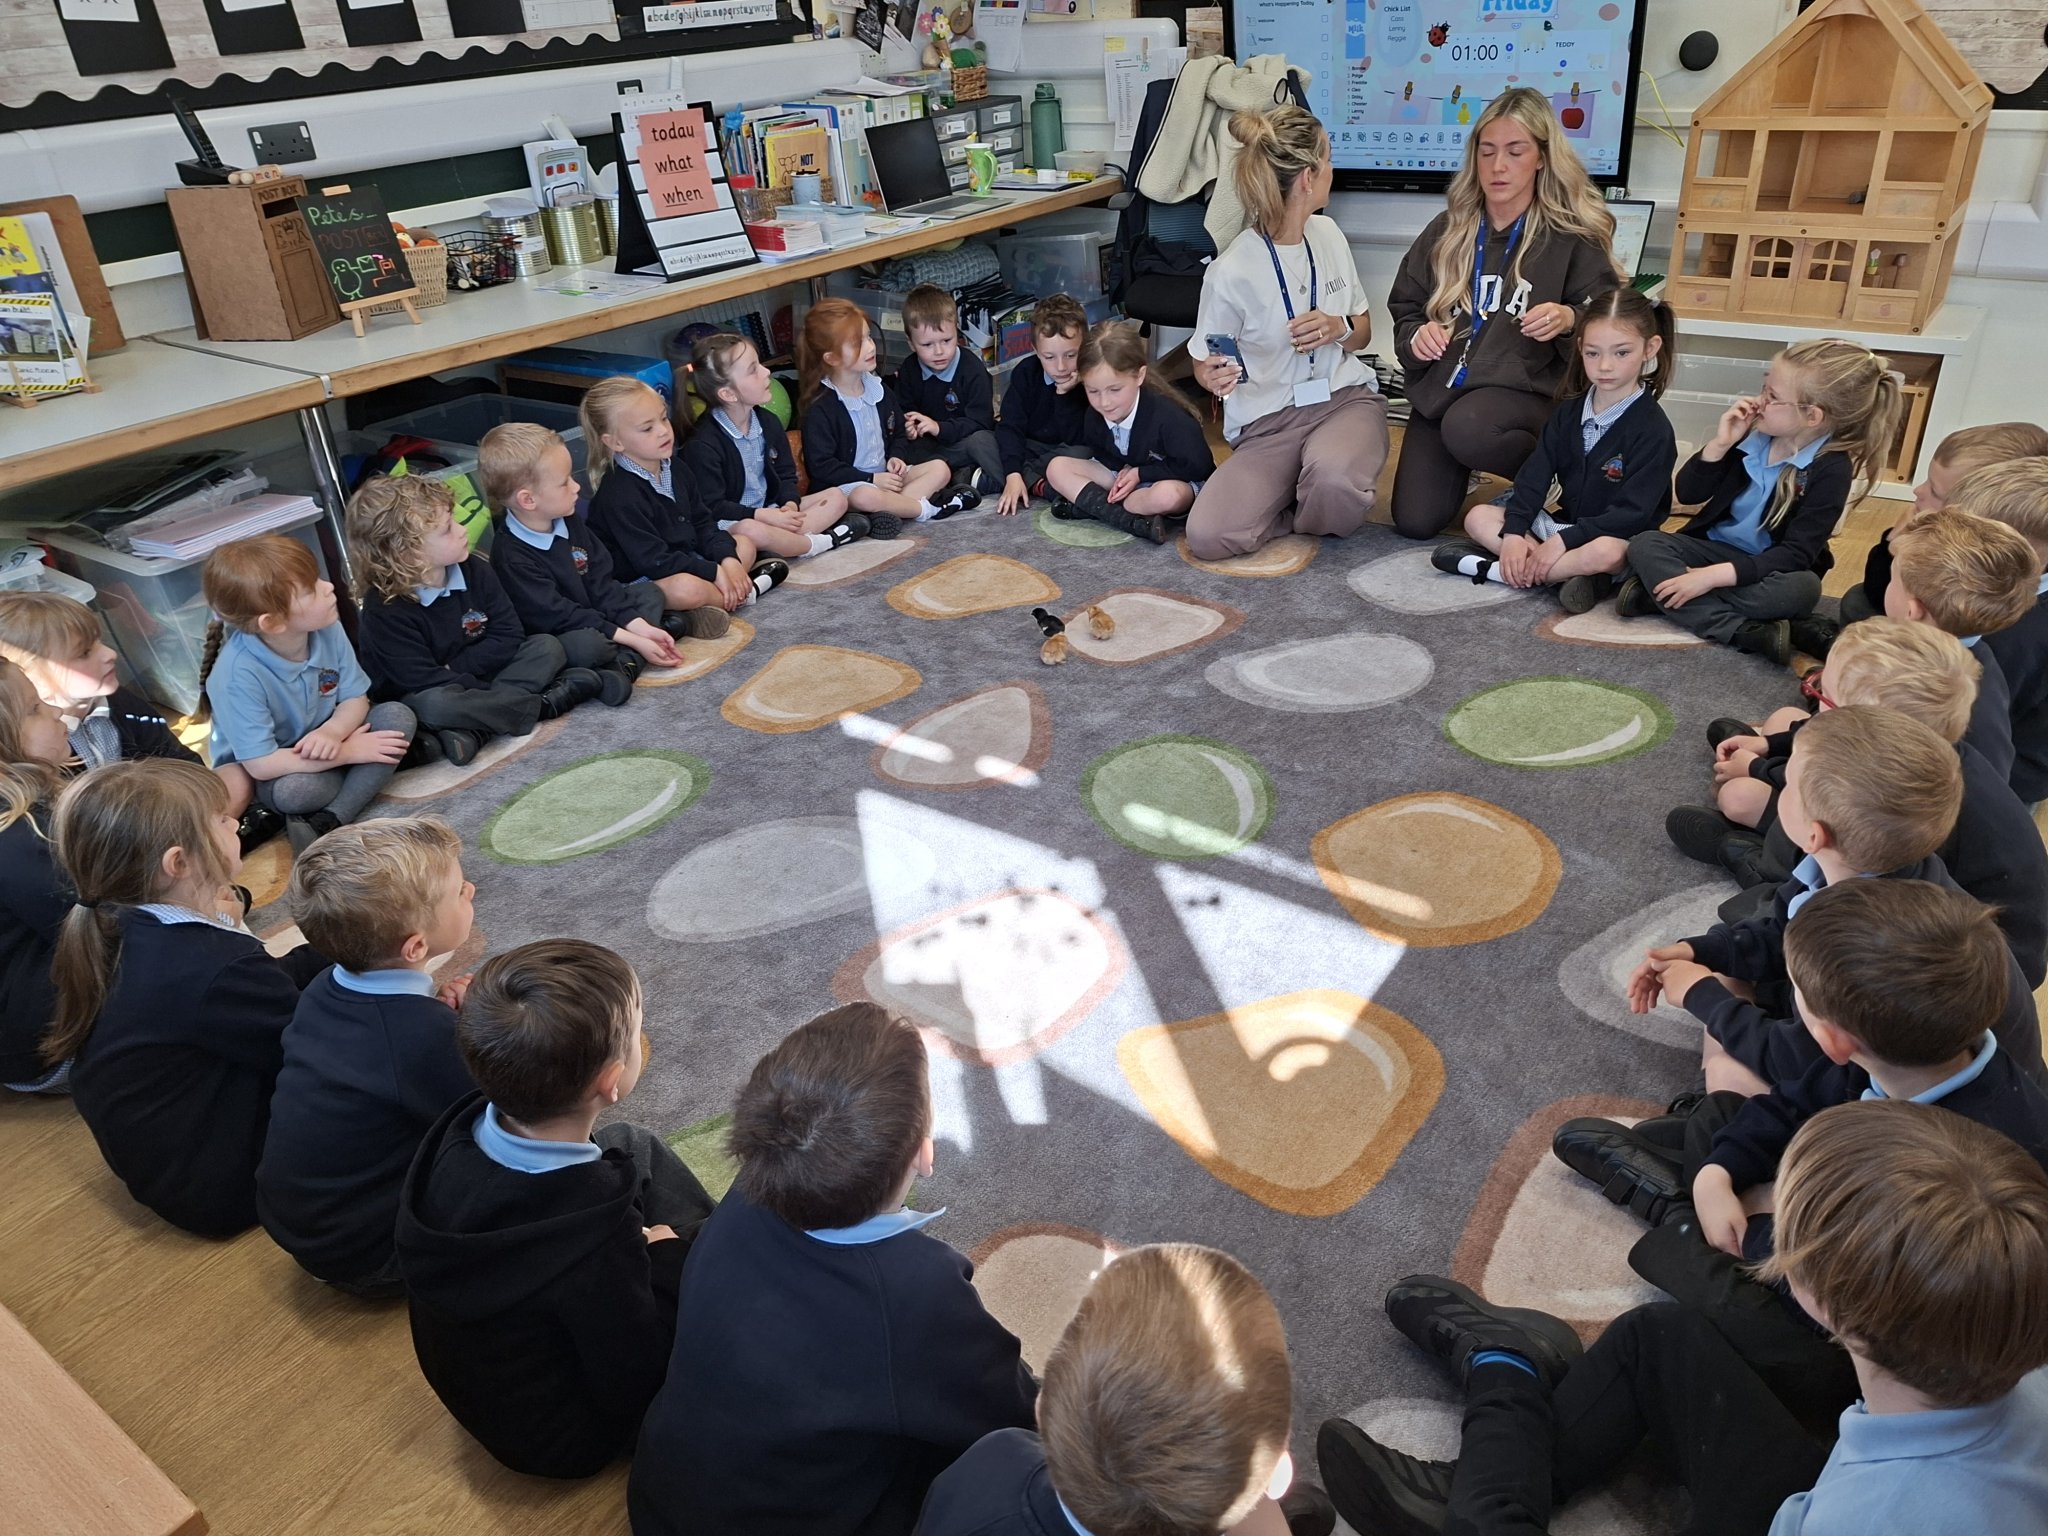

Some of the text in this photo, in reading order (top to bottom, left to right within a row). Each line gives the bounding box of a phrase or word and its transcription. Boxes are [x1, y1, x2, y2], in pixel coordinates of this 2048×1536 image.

[1452, 45, 1499, 61] 01:00
[655, 154, 694, 174] what
[800, 154, 813, 167] NOT
[258, 183, 298, 201] POST BOX
[662, 185, 704, 204] when
[307, 201, 365, 226] Pete's
[318, 226, 363, 251] POST
